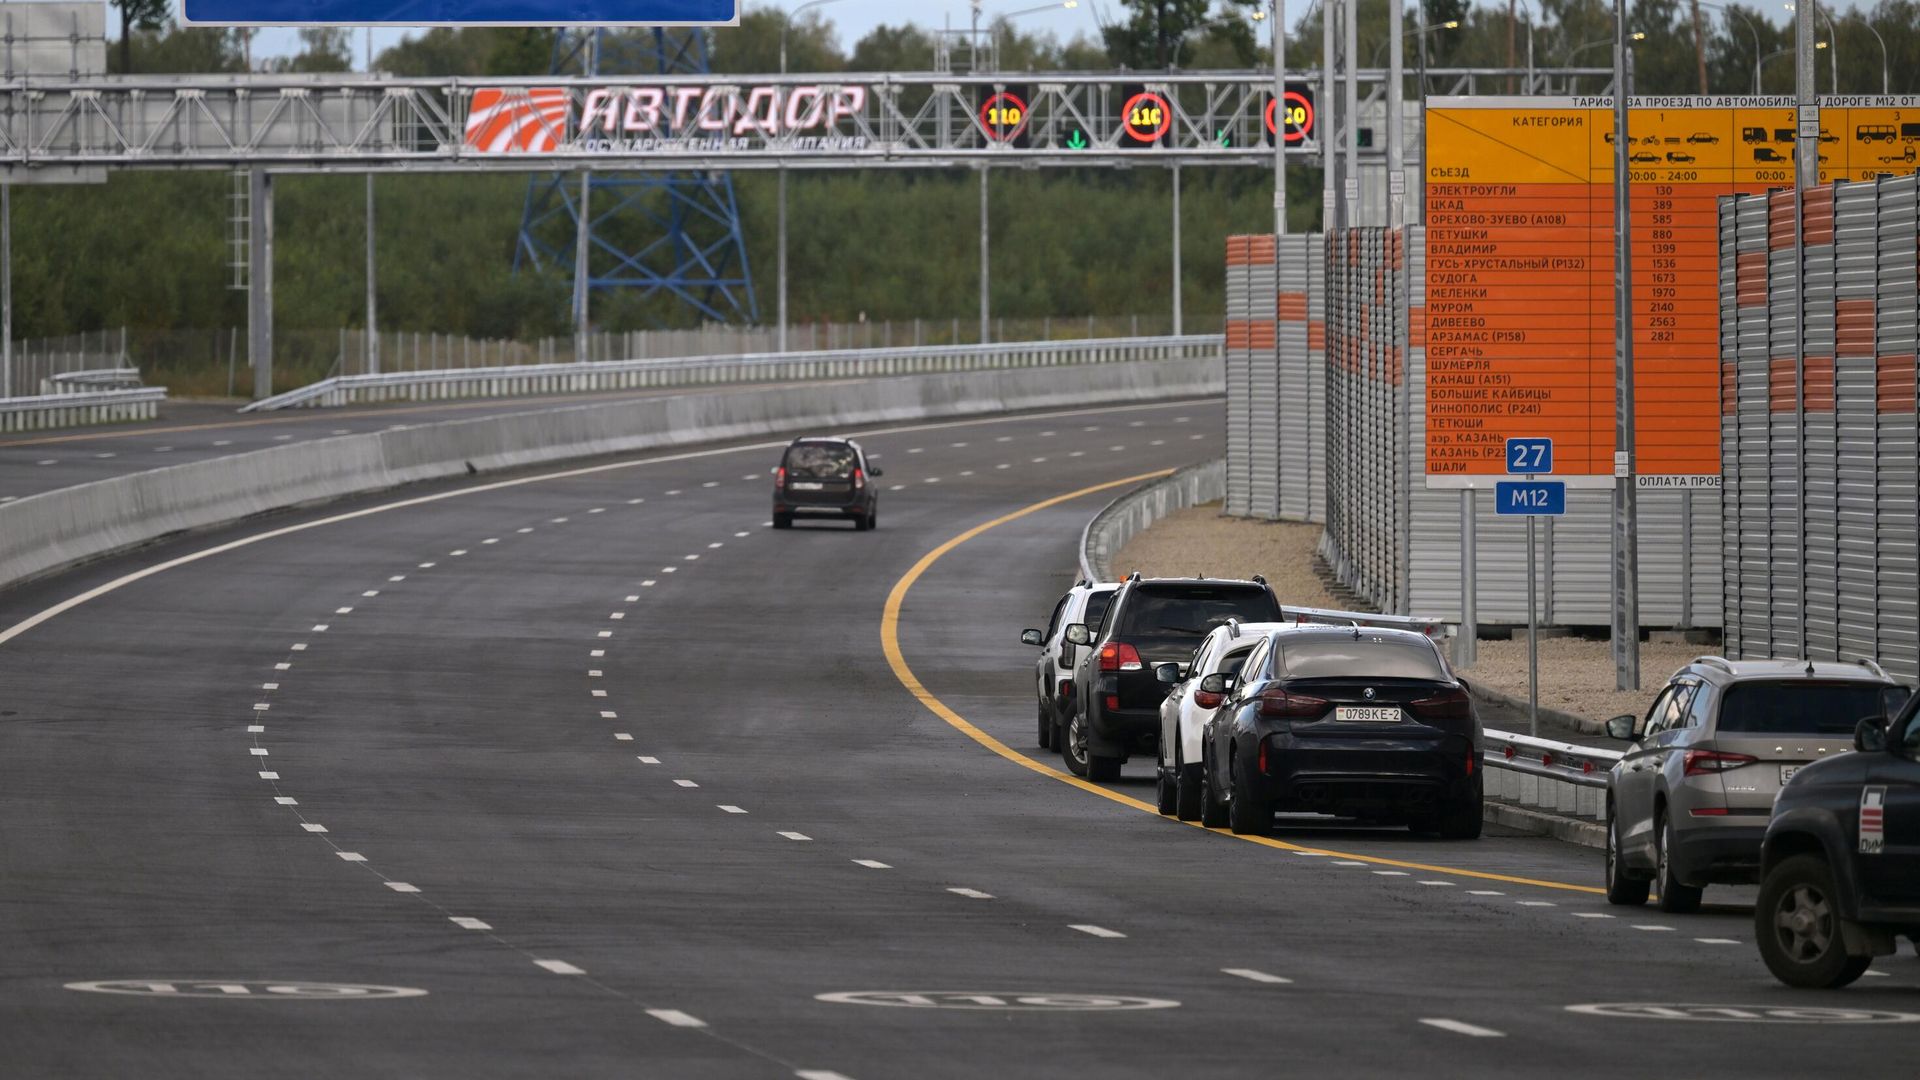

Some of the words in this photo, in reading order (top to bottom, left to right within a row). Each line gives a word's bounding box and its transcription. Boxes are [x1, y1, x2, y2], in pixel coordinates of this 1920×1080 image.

[1572, 97, 1613, 107] ТАРИФ
[1626, 97, 1642, 107] ЗА
[1645, 97, 1693, 108] ПРОЕЗД
[1696, 97, 1712, 107] ПО
[1715, 96, 1822, 107] АВТОМОБИЛЬЙ
[1824, 96, 1871, 107] ДОРОГЕ
[1875, 96, 1896, 107] М12
[1900, 96, 1917, 106] ОТ
[579, 87, 864, 134] АВТОДОР
[988, 108, 1021, 125] 110
[1130, 108, 1161, 125] 110
[1512, 116, 1583, 127] КАТЕГОРИЯ
[1660, 112, 1664, 123] 1
[1787, 111, 1794, 122] 2
[1894, 111, 1901, 122] 3
[1430, 167, 1470, 178] СЪЕЗД
[1667, 171, 1698, 181] 24:00
[1755, 170, 1786, 181] 00:00
[1431, 185, 1517, 196] ЭЛЕКТРОУГЛИ
[1655, 185, 1673, 196] 130
[1430, 199, 1465, 212] ЦКАД
[1653, 199, 1673, 210] 389
[1431, 214, 1528, 225] ОРЕХОВО-ЗУЕВО
[1530, 214, 1567, 225] (А108)
[1652, 214, 1672, 225] 585
[1430, 229, 1488, 240] ПЕТУШКИ
[1652, 229, 1673, 240] 880
[1430, 244, 1497, 255] ВЛАДИМИР
[1652, 243, 1676, 254] 1399
[1430, 258, 1549, 269] ГУСЬ-ХРУСТАЛЬНЫЙ
[1551, 258, 1585, 271] (Р132)
[1652, 258, 1676, 269] 1536
[1430, 272, 1478, 284] СУДОГА
[1652, 272, 1676, 283] 1673
[1430, 288, 1488, 298] МЕЛЕНКИ
[1652, 287, 1676, 298] 1970
[1430, 303, 1473, 313] МУРОМ
[1650, 302, 1675, 313] 2140
[1431, 316, 1486, 328] ДИВЕЕВО
[1649, 316, 1676, 327] 2563
[1431, 331, 1489, 342] АРЗАМАС
[1492, 331, 1526, 342] (Р158)
[1650, 331, 1674, 342] 2821
[1430, 346, 1484, 357] СЕРГАЧЬ
[1431, 360, 1490, 371] ШУМЕРЛЯ
[1431, 375, 1475, 385] КАНАШ
[1478, 374, 1511, 386] (А151)
[1431, 389, 1489, 400] БОЛЬШИЕ
[1492, 389, 1551, 400] КАЙБИЦЫ
[1431, 403, 1503, 414] ИННОПОЛИС
[1507, 403, 1541, 415] (Р241)
[1431, 418, 1484, 429] ТЕТЮШИ
[1431, 435, 1453, 444] аэр.
[1456, 433, 1505, 444] КАЗАНЬ
[1430, 447, 1479, 458] КАЗАНЬ
[1482, 446, 1507, 459] (Р23
[1513, 444, 1546, 467] 27
[1430, 462, 1467, 473] ШАЛИ
[1639, 476, 1687, 487] ОПЛАТА
[1691, 477, 1721, 486] ПРОЕ
[1511, 489, 1548, 506] М12
[1346, 709, 1400, 720] 0789KE-2
[126, 984, 368, 995] 110
[870, 995, 1121, 1006] 110
[1617, 1006, 1873, 1019] 110
